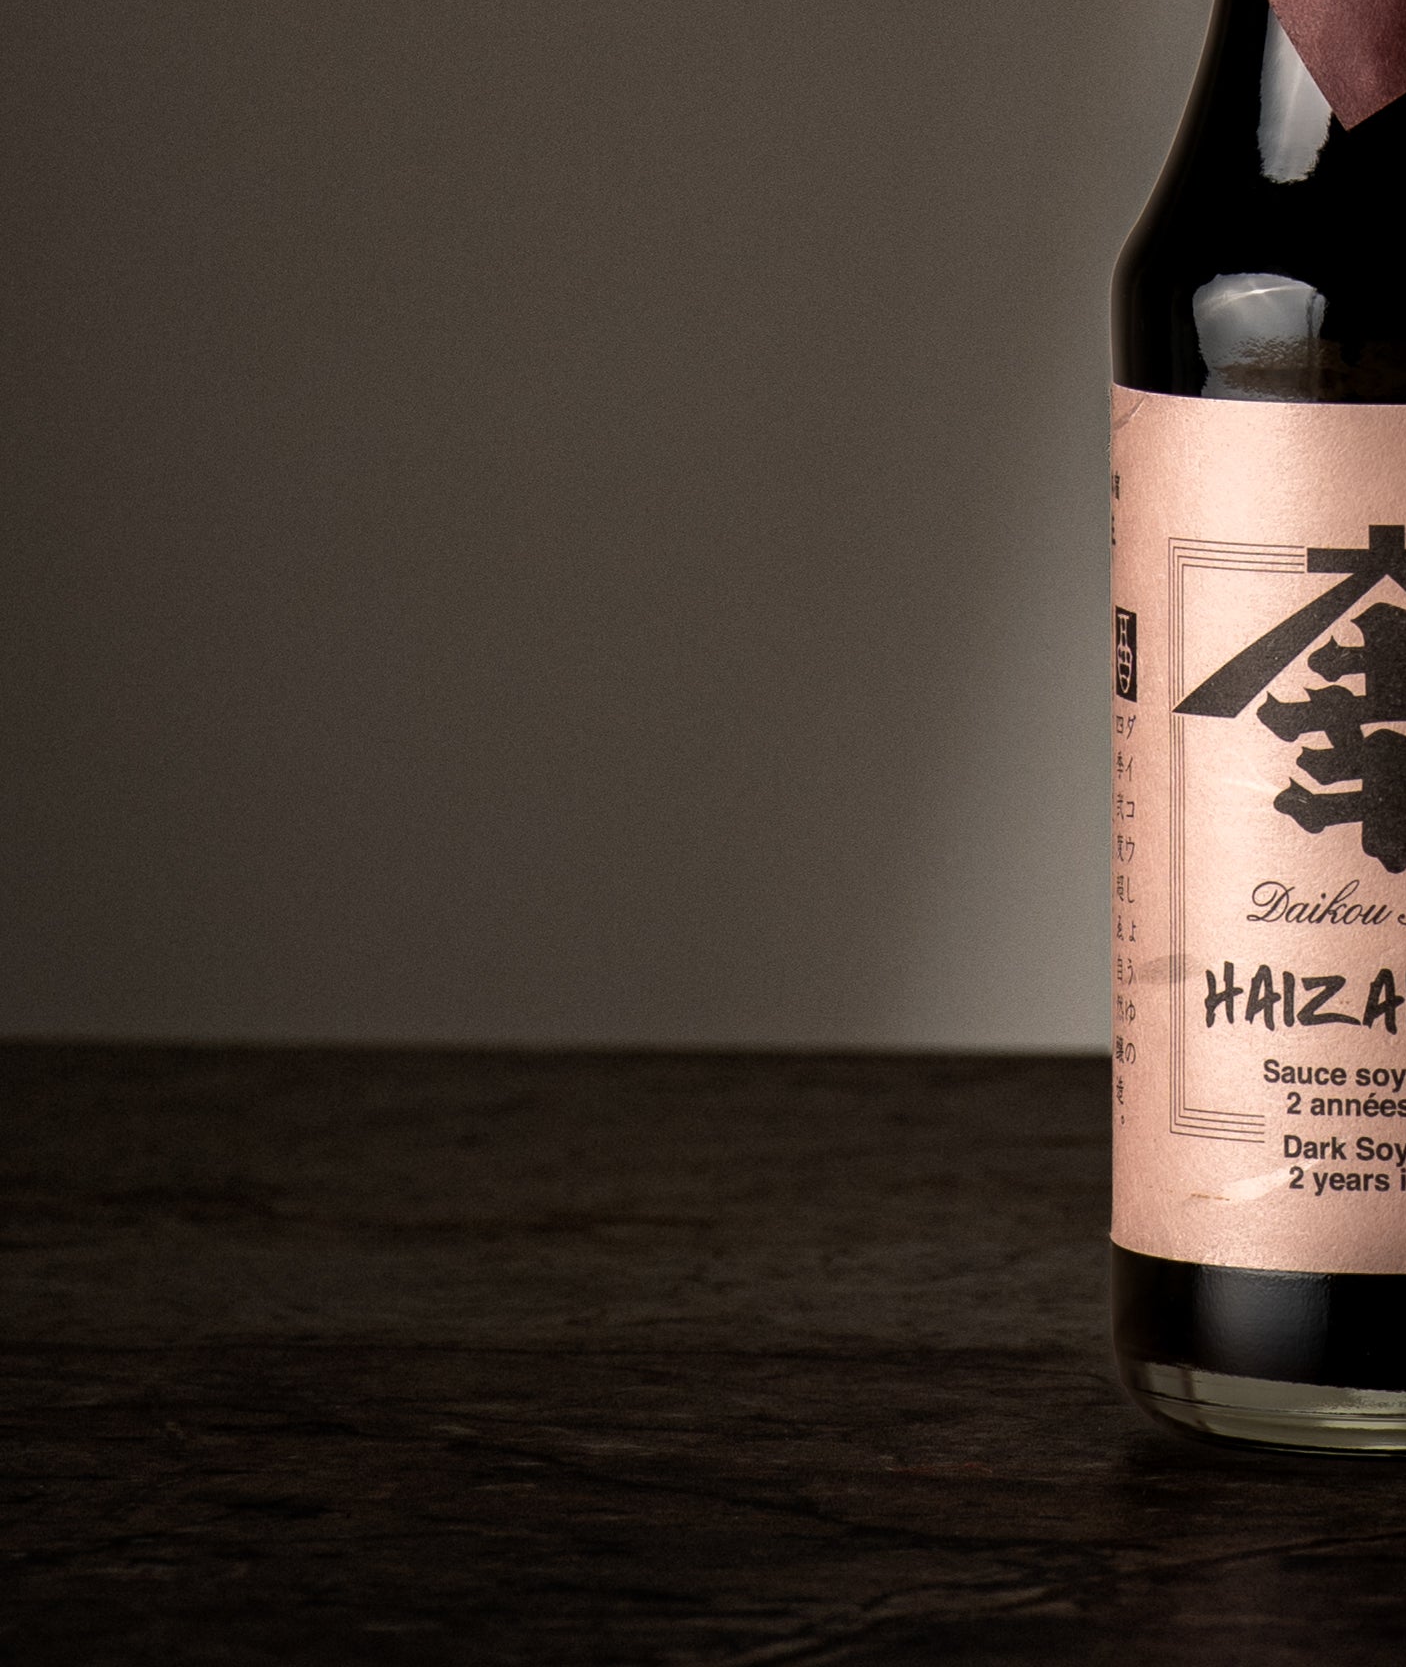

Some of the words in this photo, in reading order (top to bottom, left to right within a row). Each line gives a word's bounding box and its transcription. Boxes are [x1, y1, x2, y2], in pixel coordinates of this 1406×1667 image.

[1246, 880, 1391, 925] Daikou
[1263, 1058, 1347, 1086] Sauce
[1286, 1092, 1302, 1115] 2
[1283, 1135, 1347, 1161] Dark
[1289, 1167, 1305, 1190] 2
[1312, 1172, 1391, 1197] years
